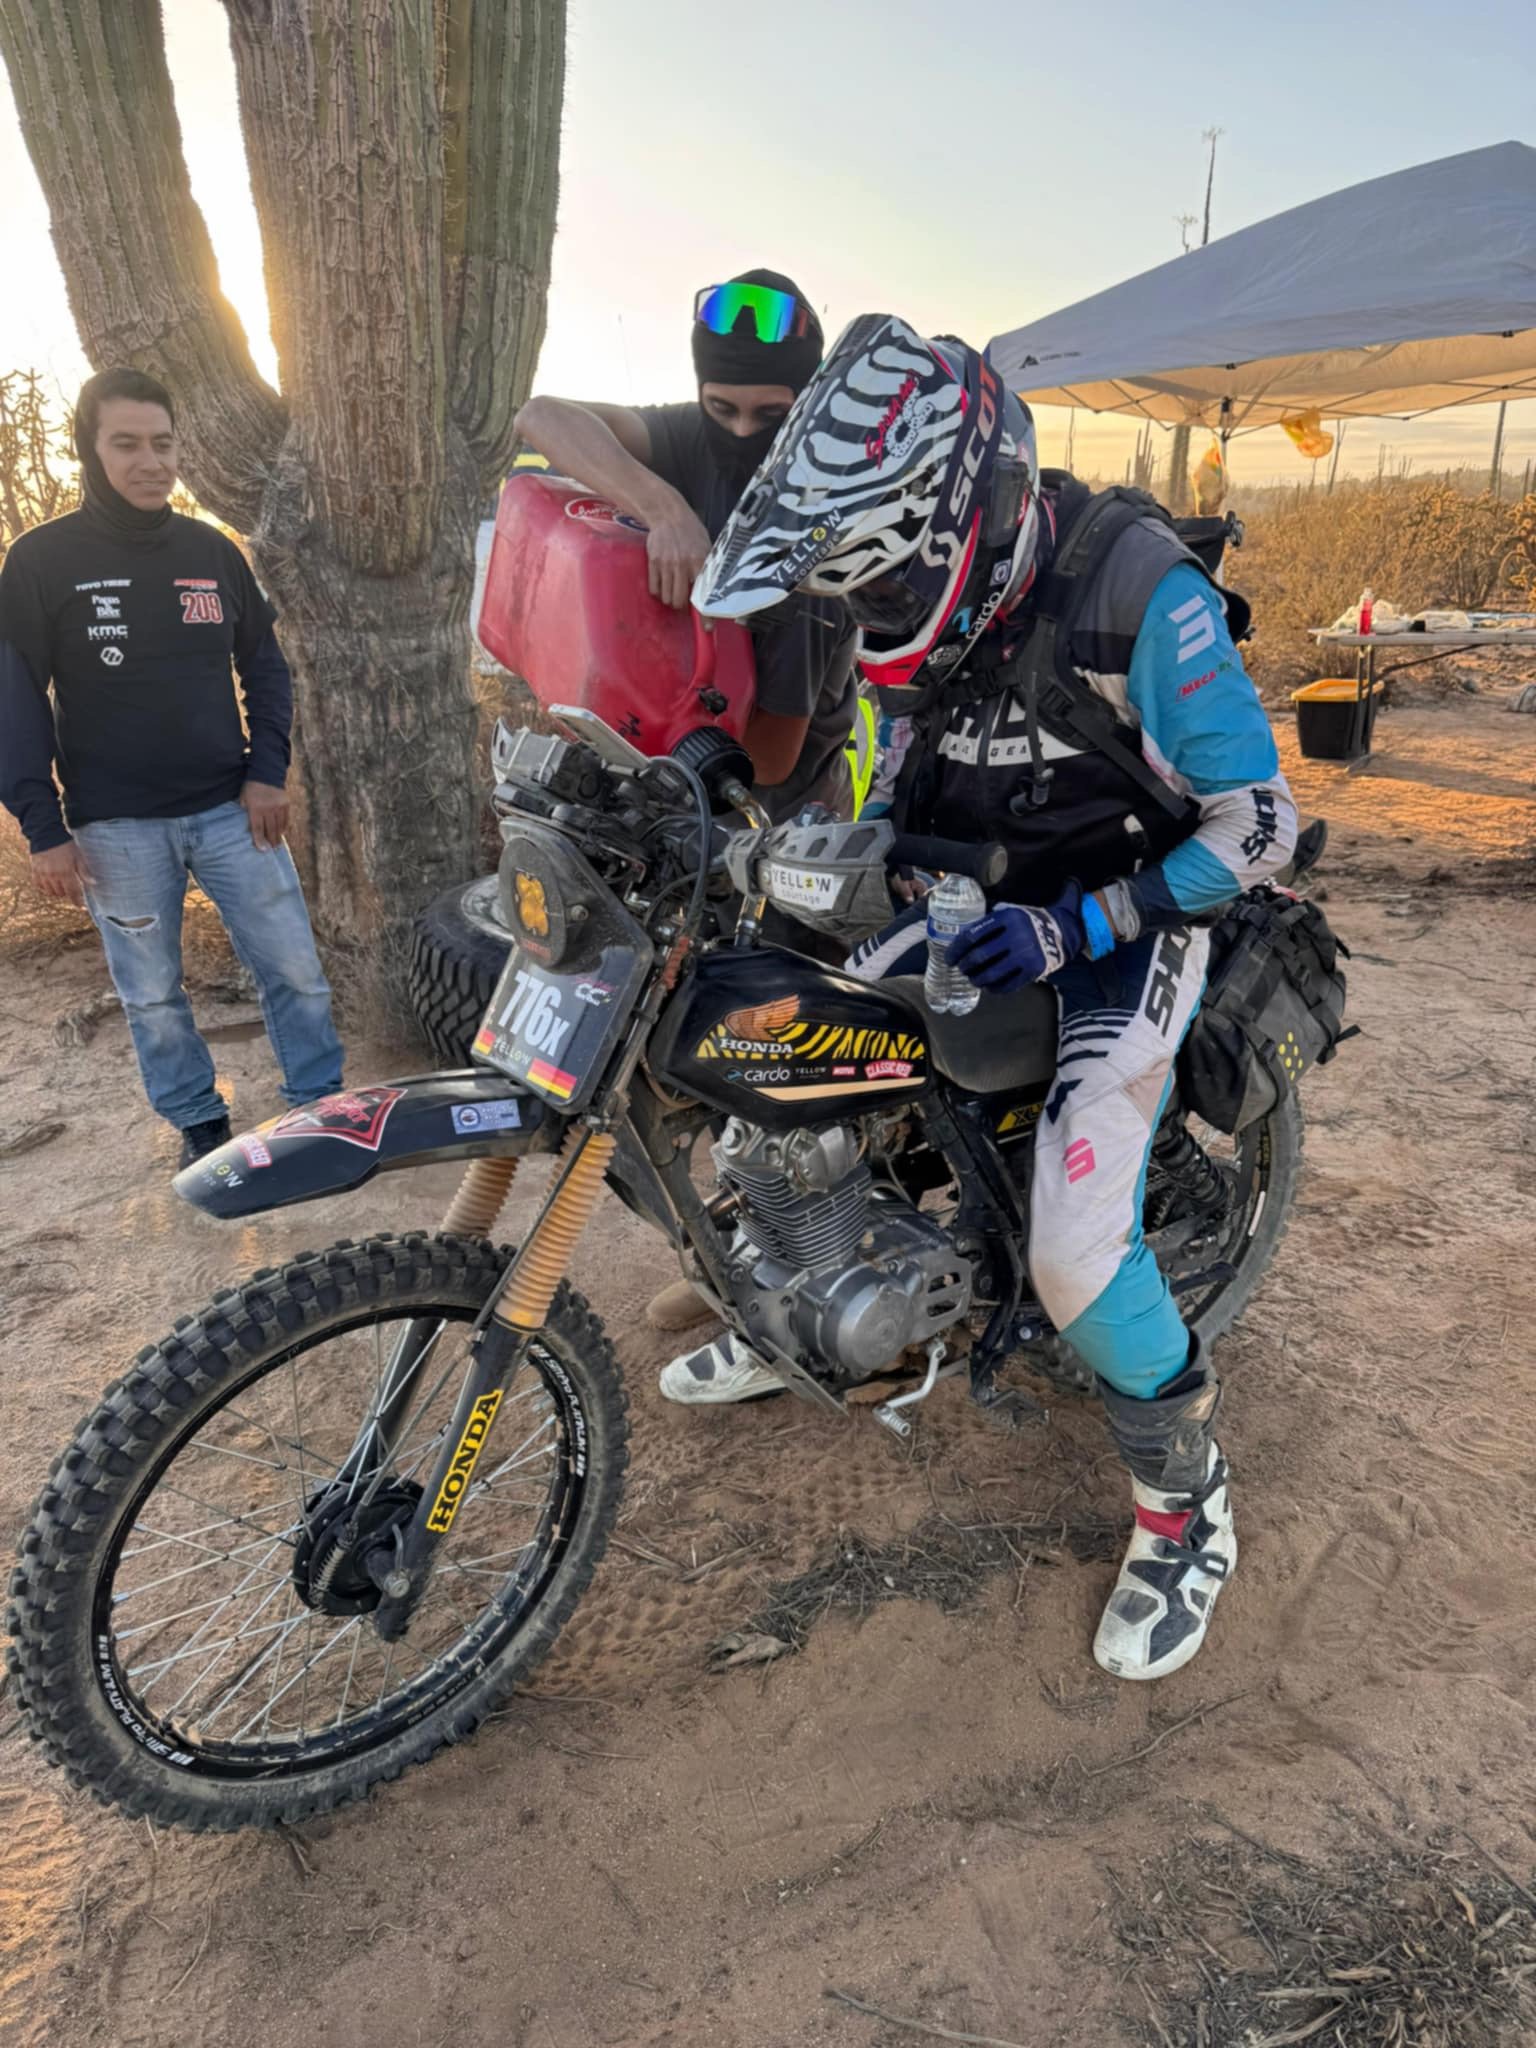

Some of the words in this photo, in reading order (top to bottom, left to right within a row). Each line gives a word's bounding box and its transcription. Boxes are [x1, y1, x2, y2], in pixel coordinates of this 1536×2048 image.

[795, 533, 840, 583] courtage
[180, 592, 223, 624] 209
[966, 590, 1001, 640] cardo
[990, 744, 1044, 758] GEA
[1145, 922, 1193, 1039] SHO
[720, 1038, 793, 1053] HONDA
[744, 1066, 790, 1082] cardo
[431, 1395, 497, 1529] HONDA
